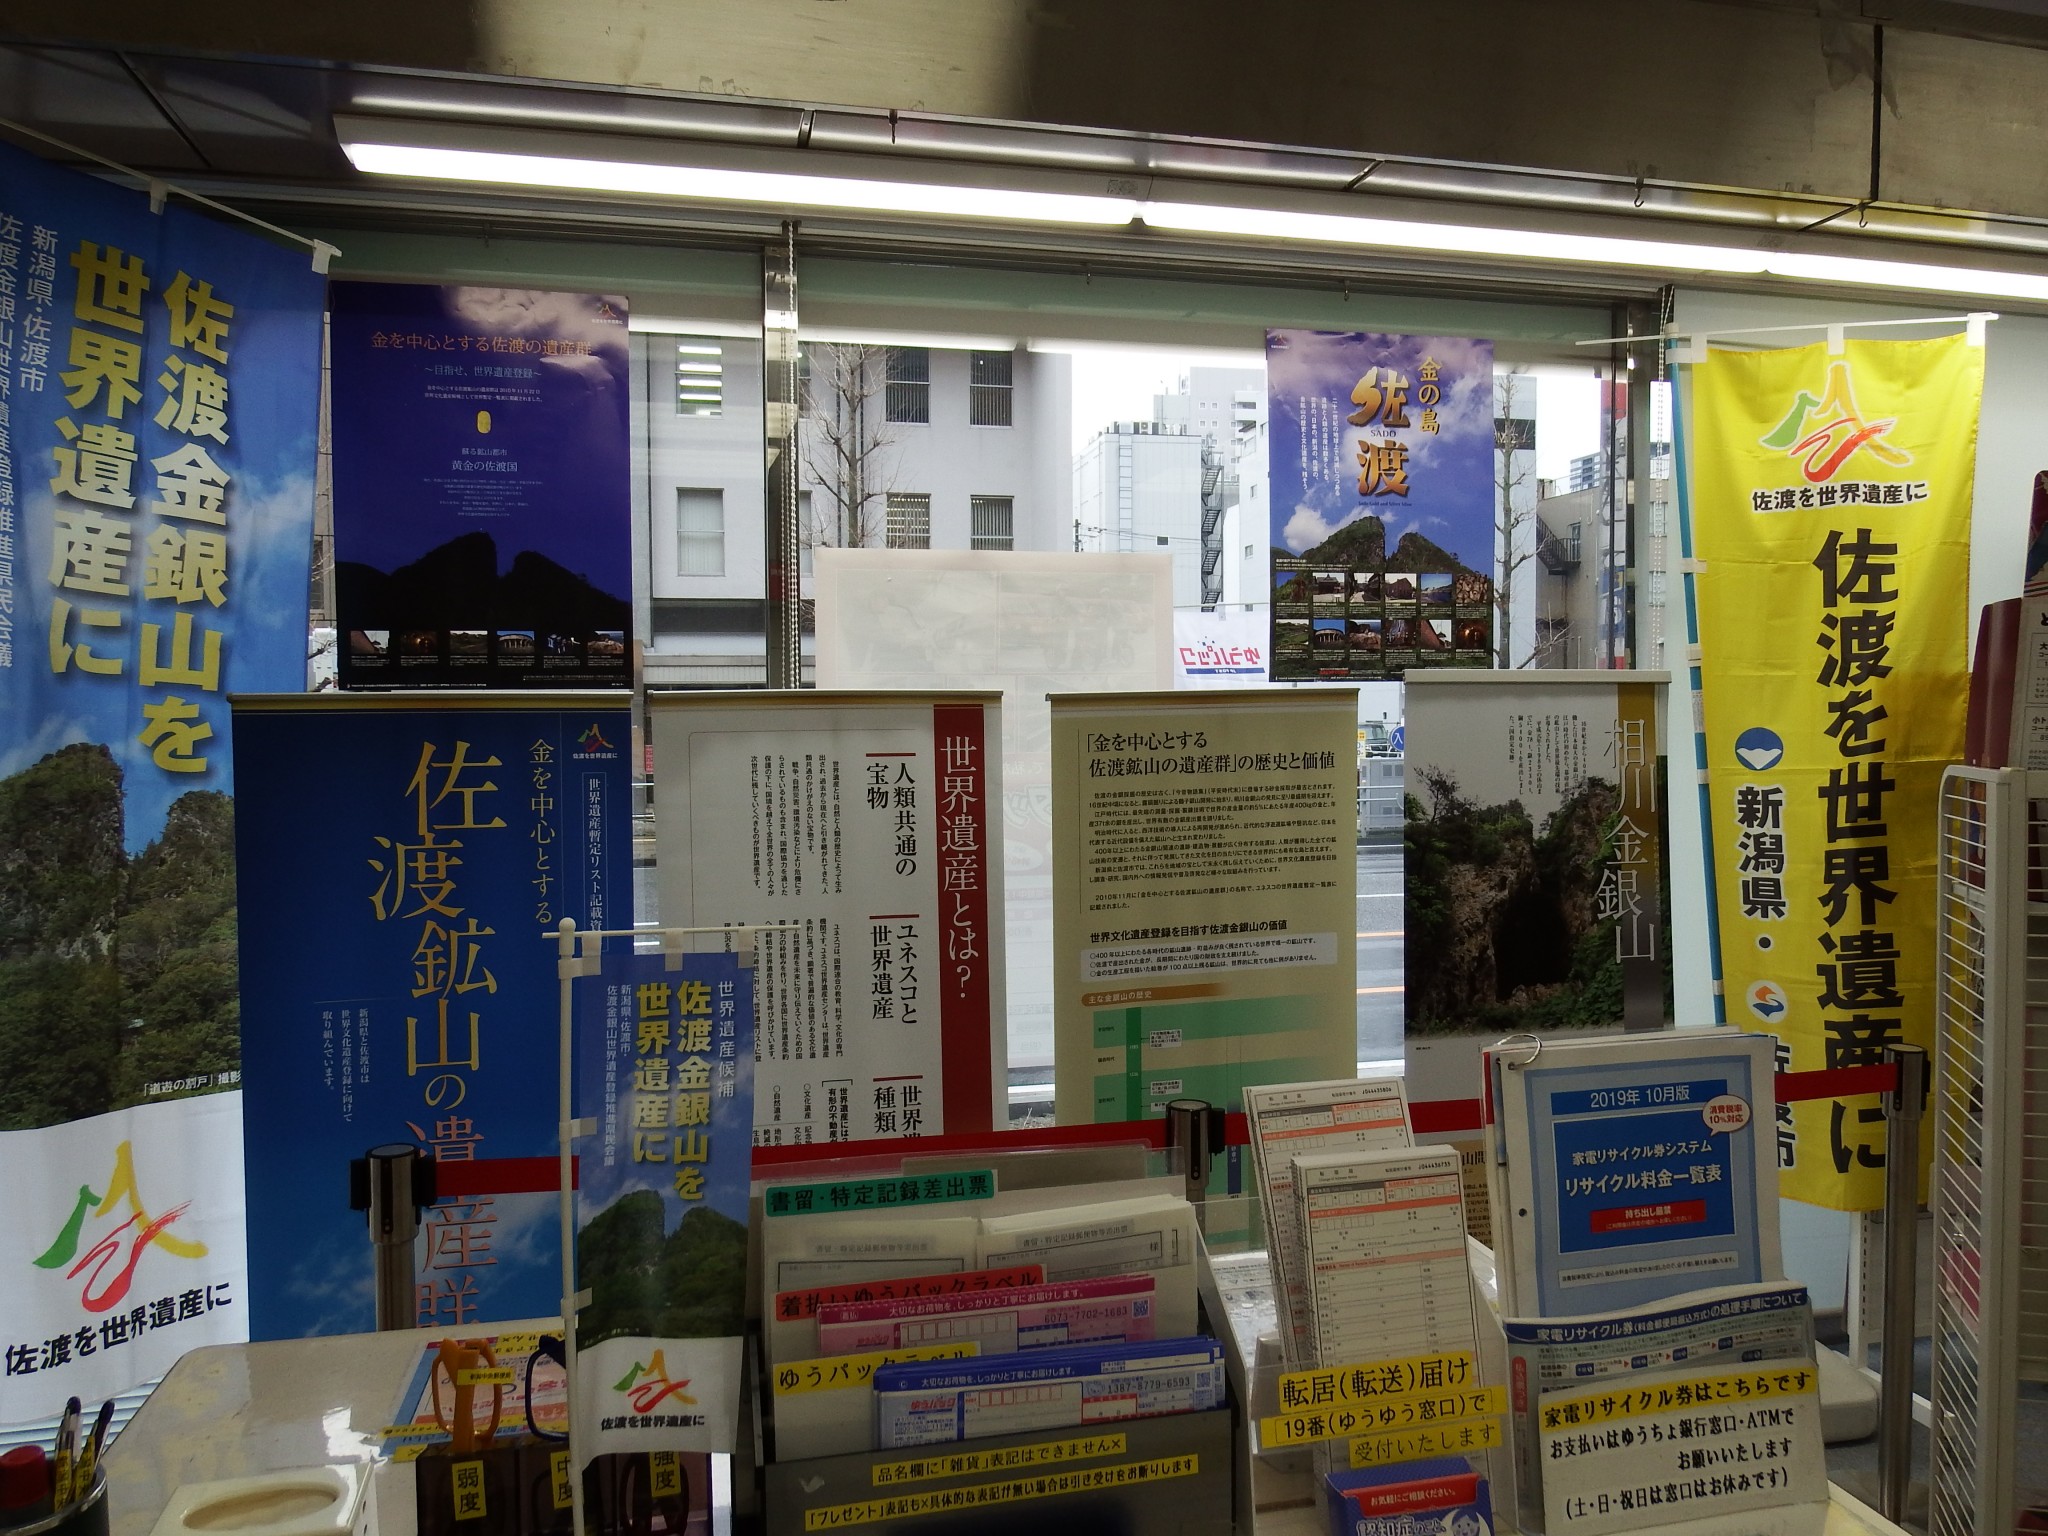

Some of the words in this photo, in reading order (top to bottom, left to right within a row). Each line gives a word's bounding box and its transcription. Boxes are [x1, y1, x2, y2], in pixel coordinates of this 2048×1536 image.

[20, 225, 58, 392] 新潟県・佐渡市
[371, 331, 592, 357] 金を中心とする佐渡の遺産群
[1418, 355, 1442, 435] 金の島
[1347, 366, 1411, 497] 佐渡
[1370, 429, 1397, 438] SADO
[47, 239, 151, 674] 世界遺産に
[1752, 482, 1928, 511] 佐渡を世界遺産に
[137, 270, 235, 773] 佐渡金銀山を
[1087, 731, 1208, 753] 「金を中心とする
[1089, 751, 1335, 777] 佐渡鉱山の遺産群」の歴史と価値
[866, 763, 889, 810] 宝物
[529, 738, 556, 924] 金を中心とする
[893, 763, 917, 876] 人類共通の
[1595, 719, 1657, 964] 相川金銀山
[940, 735, 980, 999] 世界遺産とは？
[1090, 919, 1288, 944] 世界文化遺産登録を目指す佐渡金銀山の価値
[765, 920, 775, 1060] へ締結や世界遺産の保護を呼びかけています。
[793, 919, 802, 1060] 産自然遺産を未来に守り伝えていくための国
[870, 924, 894, 1020] 世界遺産
[896, 923, 919, 1024] ユネスコと
[322, 1011, 335, 1091] 取り組んでいます。
[359, 1008, 370, 1083] 新潟県と佐渡市は
[718, 981, 736, 1098] 世界遺産候補
[632, 982, 671, 1163] 世界遺産に
[673, 980, 713, 1200] 佐渡金銀山を
[1590, 1090, 1640, 1108] 2019年
[1646, 1085, 1690, 1103] 10月版
[873, 1086, 897, 1134] 種類
[1709, 1104, 1743, 1115] 消費税率
[1709, 1114, 1744, 1125] 10%対応
[1572, 1140, 1712, 1166] 家電リサイクル券システム
[771, 1174, 988, 1212] 書留・特定記録差出票
[1565, 1164, 1722, 1197] リサイクル料金一覧表
[889, 1290, 1083, 1317] 大切なお荷物を、しっかりと丁寧にお届けします。
[6, 1282, 232, 1377] 佐渡を世界遺産に
[921, 1369, 1075, 1387] 大切なお荷物を、しっかりと丁寧にお届けします。
[1283, 1358, 1469, 1407] 転居(転送)届け
[1544, 1371, 1811, 1429] 家電リサイクル券はこちらです
[601, 1414, 705, 1431] 佐渡を世界遺産に
[1284, 1394, 1486, 1439] 19番(ゆうゆう窓口)で
[1550, 1408, 1794, 1460] お支払いはゆうちょ銀行窓口・ATMで
[1355, 1424, 1494, 1463] 受付いたします
[1677, 1438, 1792, 1471] お願いいたします
[457, 1467, 480, 1514] 弱度
[654, 1450, 675, 1491] 強度
[1566, 1466, 1788, 1521] (土・日・祝日は窓口はお休みです)
[1371, 1489, 1456, 1507] お気軽にご相談ください。
